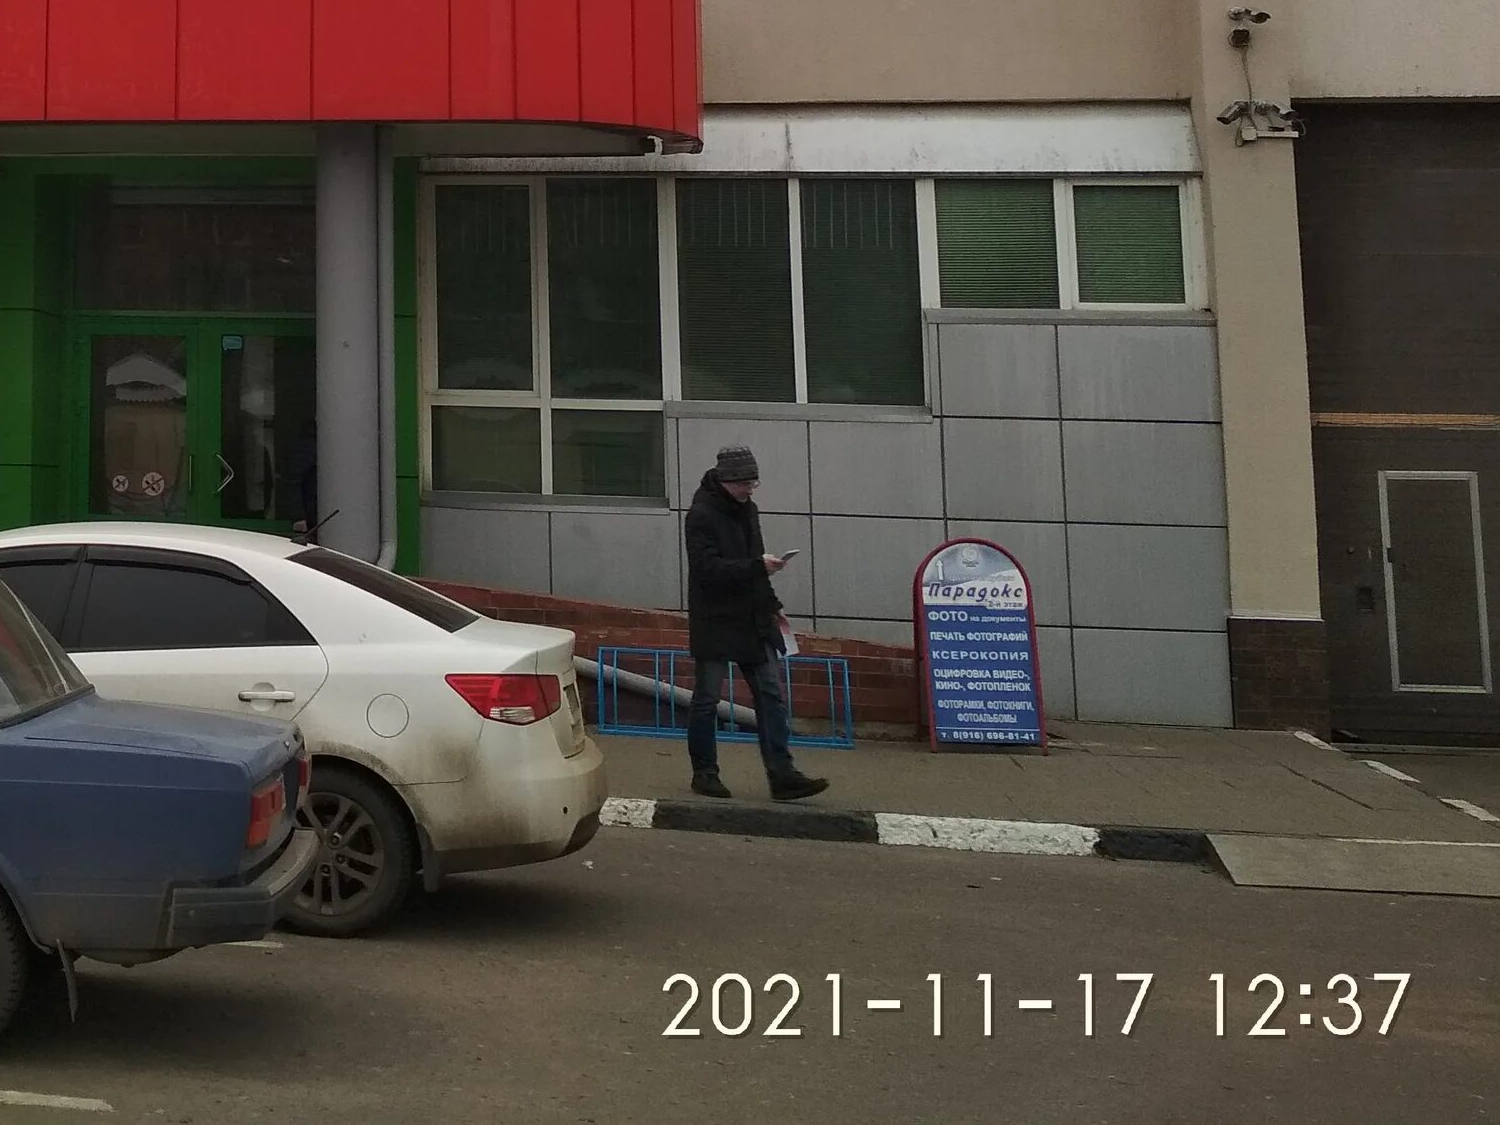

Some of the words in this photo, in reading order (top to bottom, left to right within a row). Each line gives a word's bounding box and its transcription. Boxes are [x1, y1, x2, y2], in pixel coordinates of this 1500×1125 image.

[928, 582, 1023, 602] Парадокс
[928, 610, 968, 621] ФОТО
[930, 631, 965, 641] ПЕЧАТЬ
[967, 630, 1028, 641] ФОТОГРАФИЙ
[932, 650, 1029, 661] КСЕРОКОПИЯ
[933, 668, 991, 679] ОЦИФРОВКА
[967, 681, 1031, 691] ФОТОПЛЕНОК
